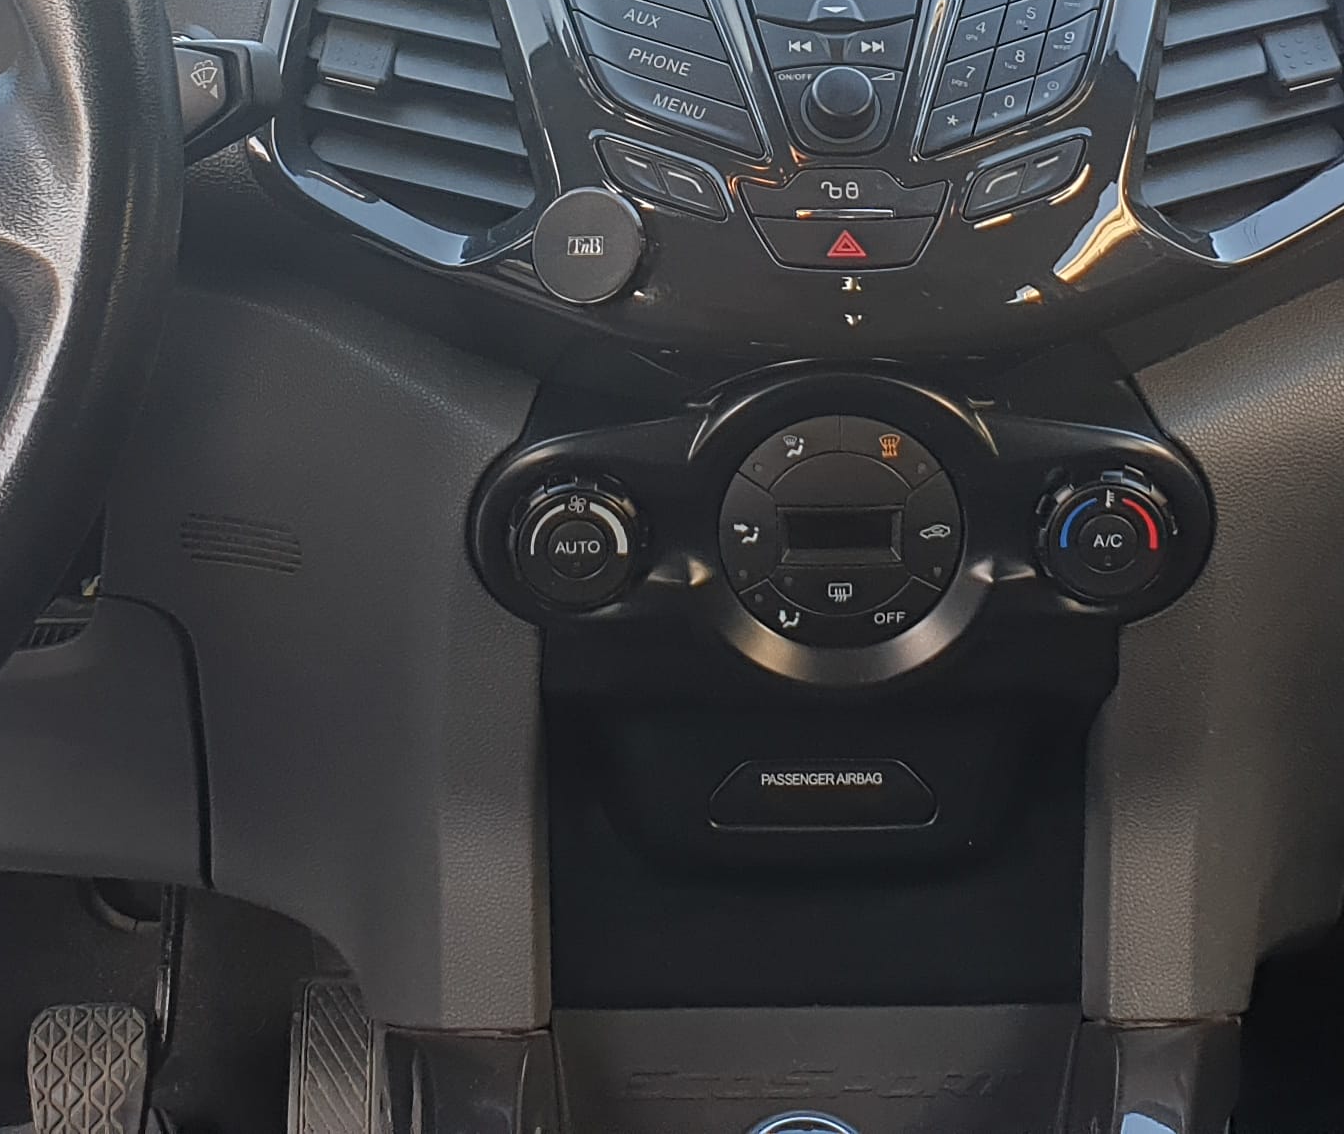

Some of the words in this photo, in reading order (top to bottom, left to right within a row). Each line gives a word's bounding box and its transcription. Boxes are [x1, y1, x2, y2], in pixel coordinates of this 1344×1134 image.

[623, 8, 661, 29] AUX
[1025, 7, 1037, 20] 5
[975, 21, 986, 34] 4
[1064, 31, 1075, 44] 9
[628, 48, 692, 77] PHONE
[1015, 49, 1025, 63] 8
[778, 73, 812, 81] ON/OFF
[966, 65, 976, 79] 7
[652, 93, 707, 120] MENU
[1004, 95, 1015, 108] 0
[554, 540, 601, 554] AUTO
[1093, 532, 1123, 549] A/C
[874, 611, 906, 626] OFF
[761, 773, 835, 786] PASSENGER
[836, 772, 883, 785] AIRBAG
